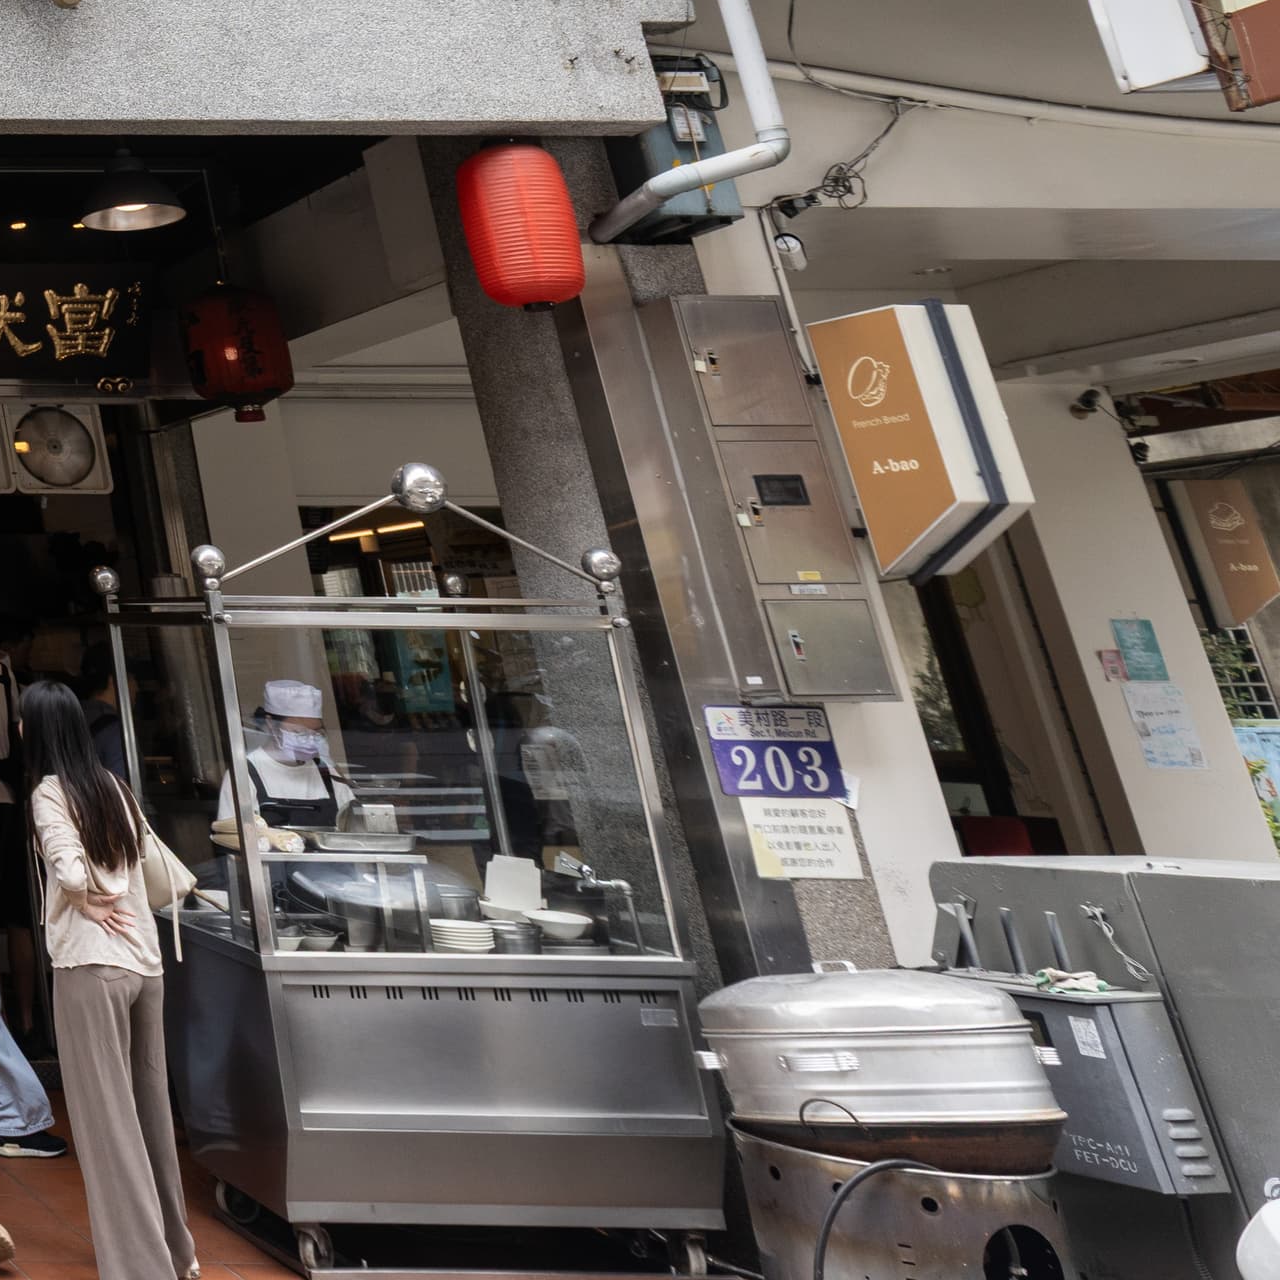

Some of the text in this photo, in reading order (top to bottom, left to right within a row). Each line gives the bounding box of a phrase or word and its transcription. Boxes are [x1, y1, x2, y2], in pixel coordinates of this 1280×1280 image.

[872, 458, 920, 475] A-bao
[737, 710, 825, 728] 美村路一段
[730, 745, 830, 792] 203
[1073, 1149, 1138, 1173] FET-DCU
